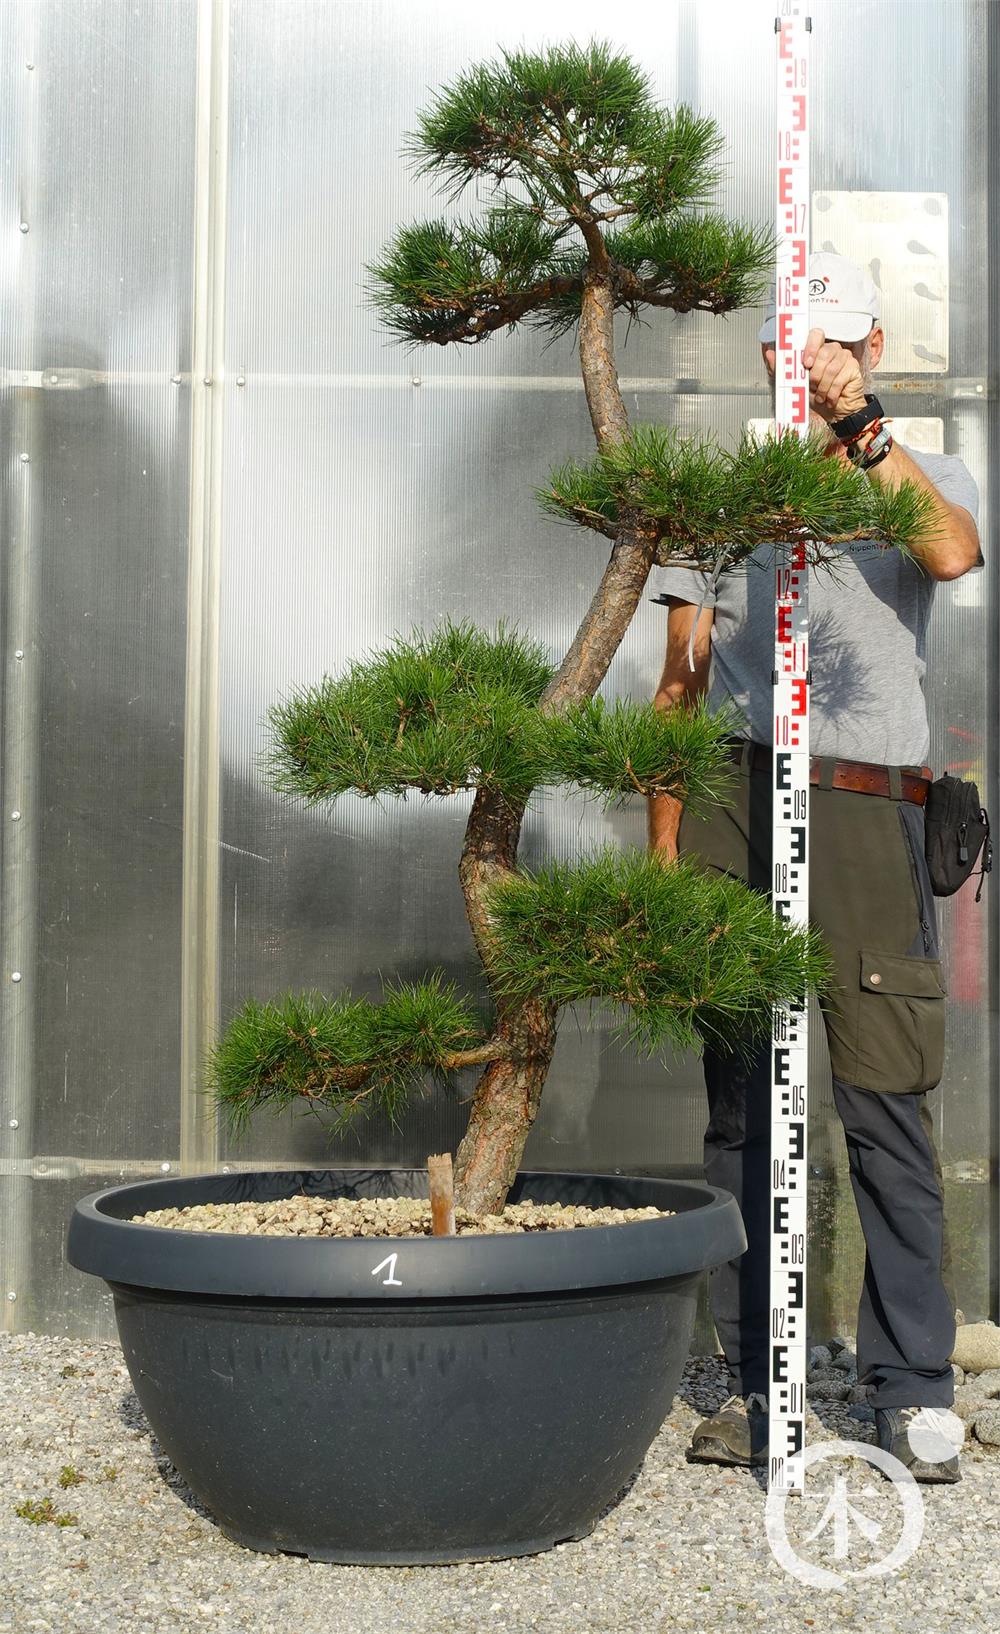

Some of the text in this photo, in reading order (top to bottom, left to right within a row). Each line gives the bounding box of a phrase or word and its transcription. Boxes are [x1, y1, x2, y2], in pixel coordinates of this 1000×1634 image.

[779, 131, 791, 161] 18
[794, 204, 807, 234] 17
[779, 276, 791, 307] 16
[778, 569, 790, 600] 12
[793, 643, 806, 672] 11
[776, 715, 788, 746] 10
[794, 790, 807, 820] 09
[775, 863, 787, 893] 08
[774, 1011, 787, 1041] 06
[792, 1085, 805, 1116] 05
[773, 1159, 785, 1190] 04
[791, 1234, 804, 1264] 03
[371, 1252, 403, 1286] 1
[772, 1308, 785, 1339] 02
[790, 1383, 803, 1414] 01
